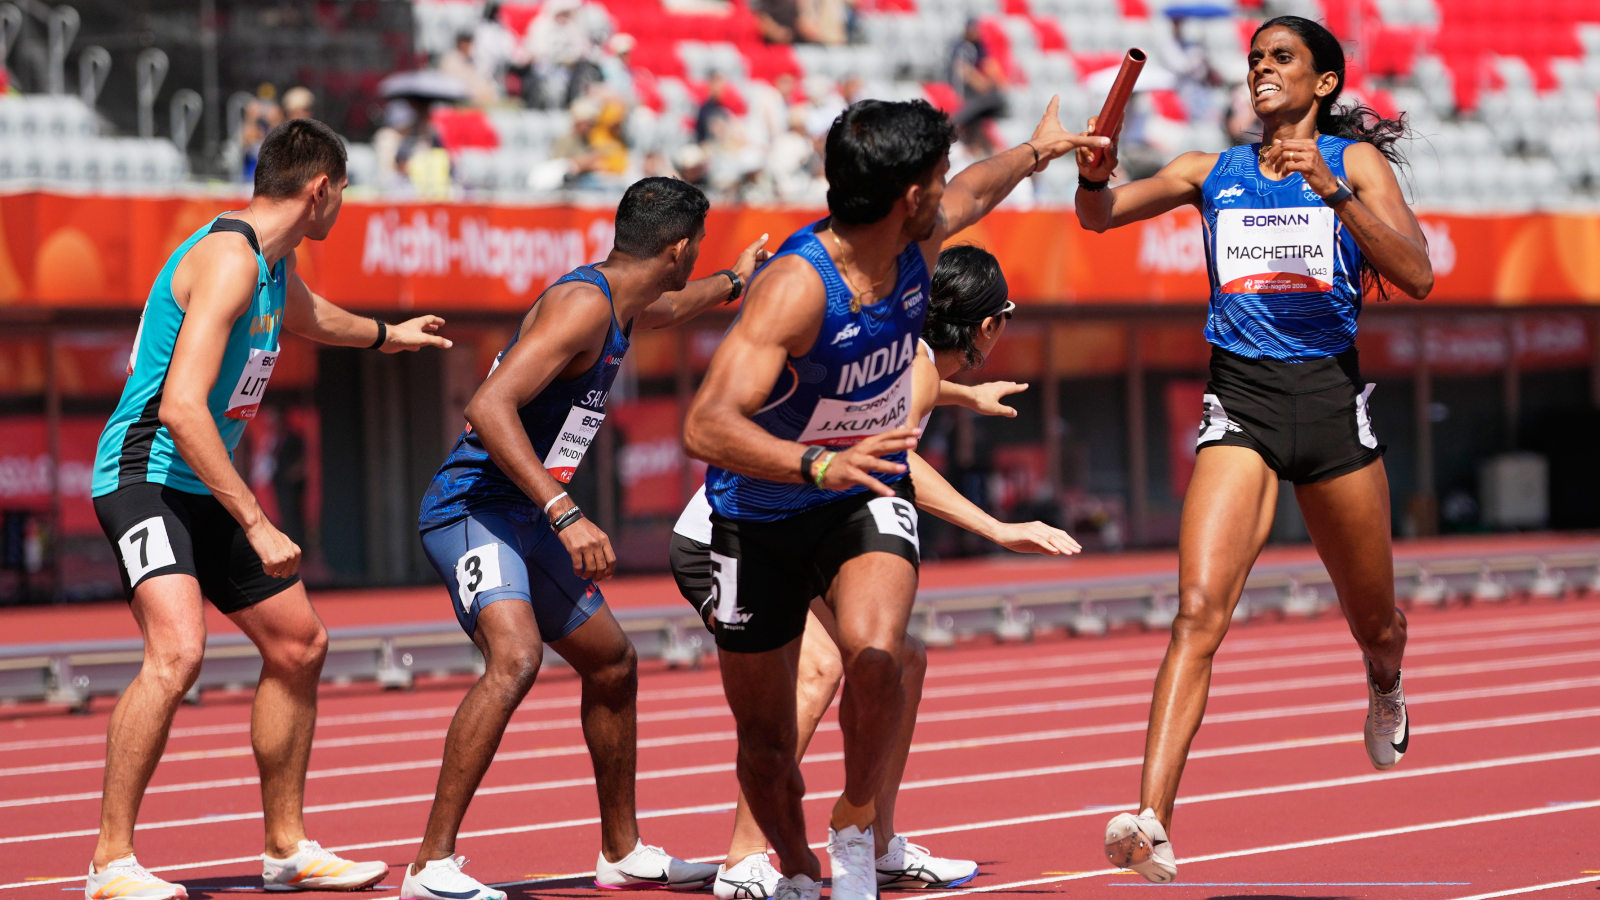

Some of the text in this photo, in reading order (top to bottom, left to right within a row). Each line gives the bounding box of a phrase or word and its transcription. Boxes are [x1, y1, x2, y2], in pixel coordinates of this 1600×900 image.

[1241, 213, 1309, 227] BORNAN
[1226, 244, 1324, 259] MACHETTIRA
[1306, 267, 1328, 277] 1043
[836, 332, 915, 395] INDIA
[817, 396, 907, 432] J.KUMAR
[891, 502, 917, 537] 5
[129, 526, 149, 569] 7
[464, 555, 483, 592] 3
